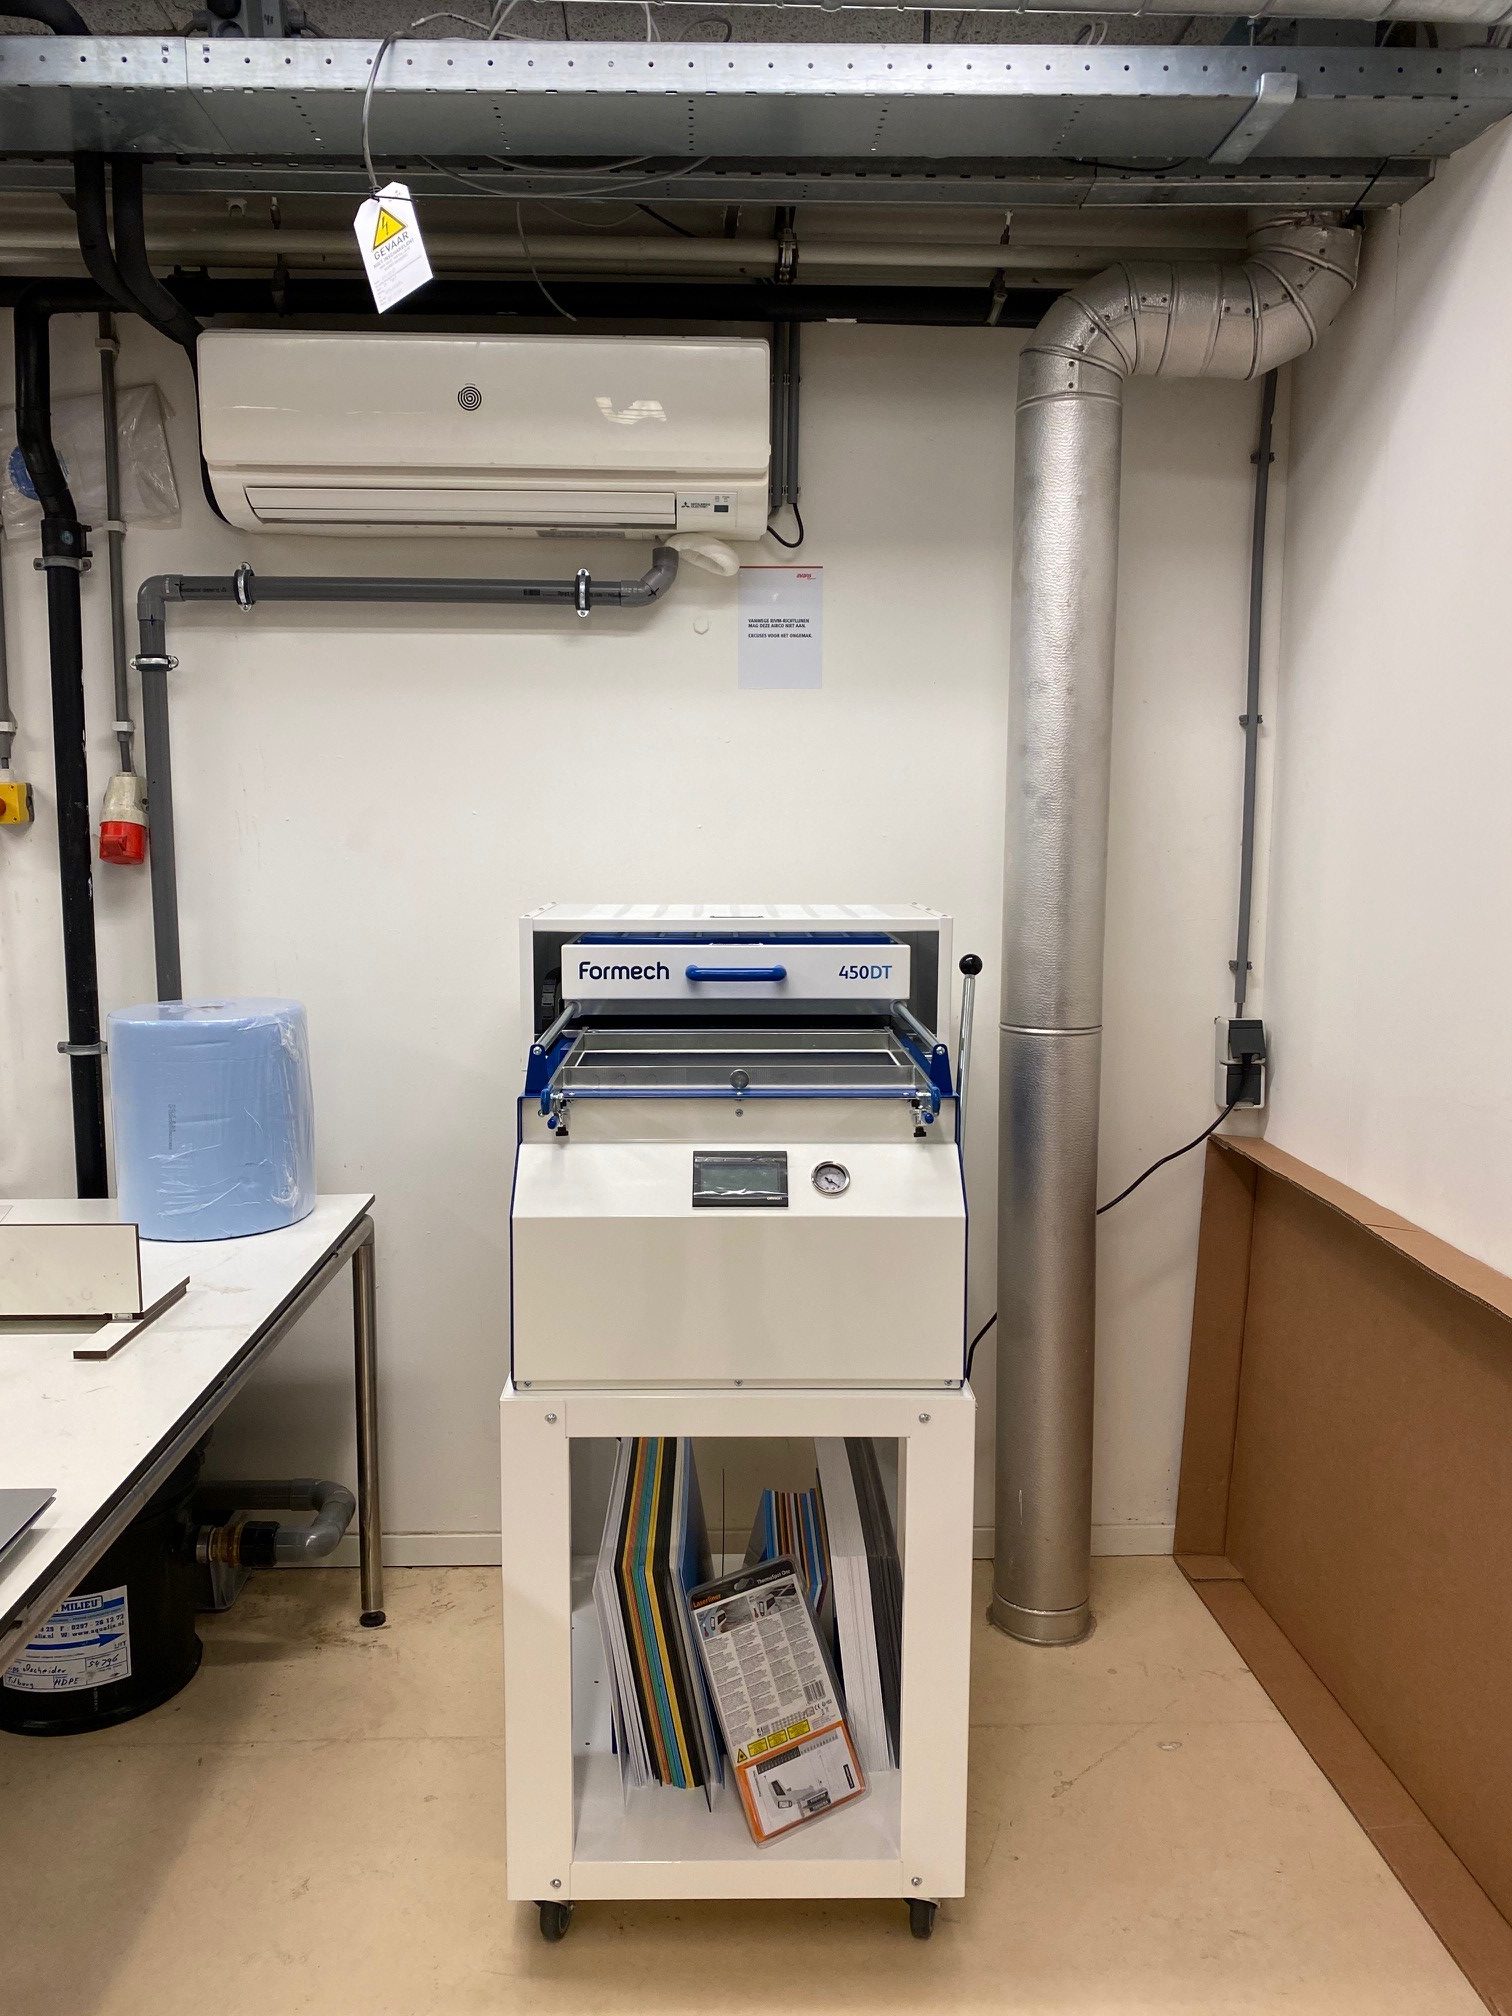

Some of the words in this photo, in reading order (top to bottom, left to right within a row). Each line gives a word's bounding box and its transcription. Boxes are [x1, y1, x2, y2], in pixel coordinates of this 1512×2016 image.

[374, 231, 409, 261] GEVAAR
[579, 961, 670, 980] Formech
[838, 964, 893, 980] 450DT
[60, 1600, 98, 1613] MILIEU
